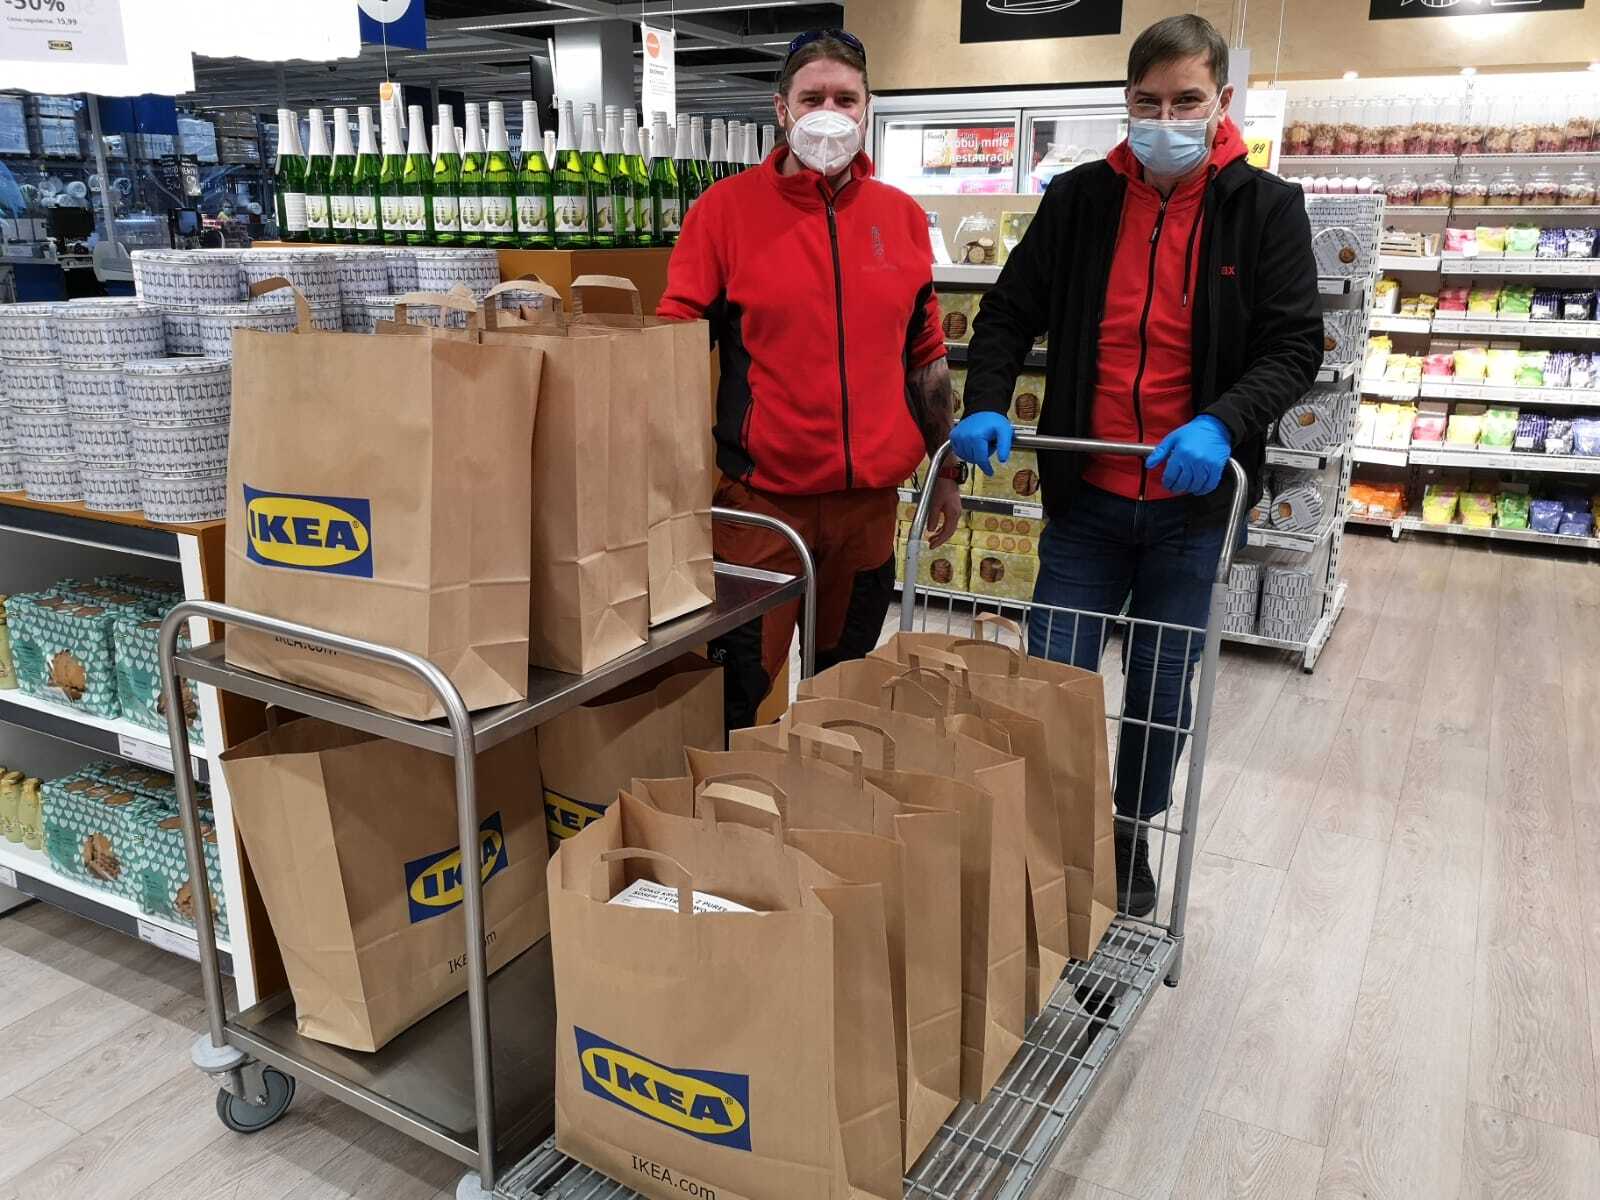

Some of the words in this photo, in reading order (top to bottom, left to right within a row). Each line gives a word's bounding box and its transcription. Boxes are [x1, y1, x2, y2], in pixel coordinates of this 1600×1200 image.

[249, 509, 360, 552] IKEA
[423, 836, 497, 899] IKA
[592, 1053, 733, 1127] IKEA
[631, 1154, 716, 1200] IKEA.com
